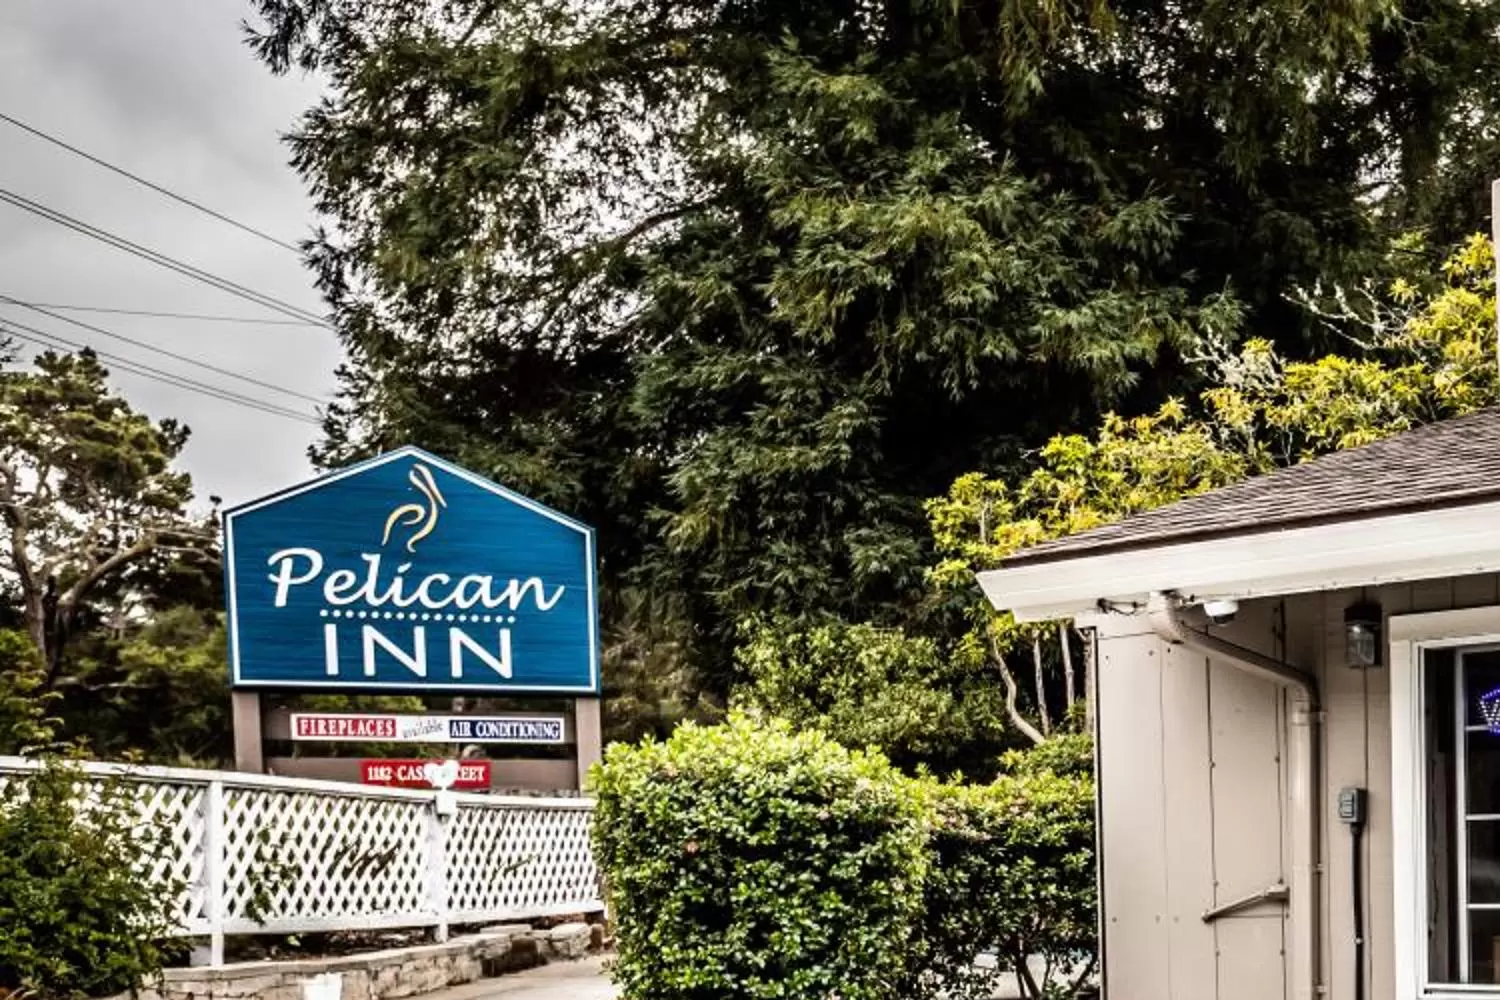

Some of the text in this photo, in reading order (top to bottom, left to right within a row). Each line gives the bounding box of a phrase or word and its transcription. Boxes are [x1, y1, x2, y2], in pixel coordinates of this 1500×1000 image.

[267, 547, 565, 612] Pelican
[324, 623, 513, 679] INN
[300, 718, 394, 737] FIREPLACES
[451, 720, 472, 737] AIR
[475, 721, 560, 739] CONDITIONING
